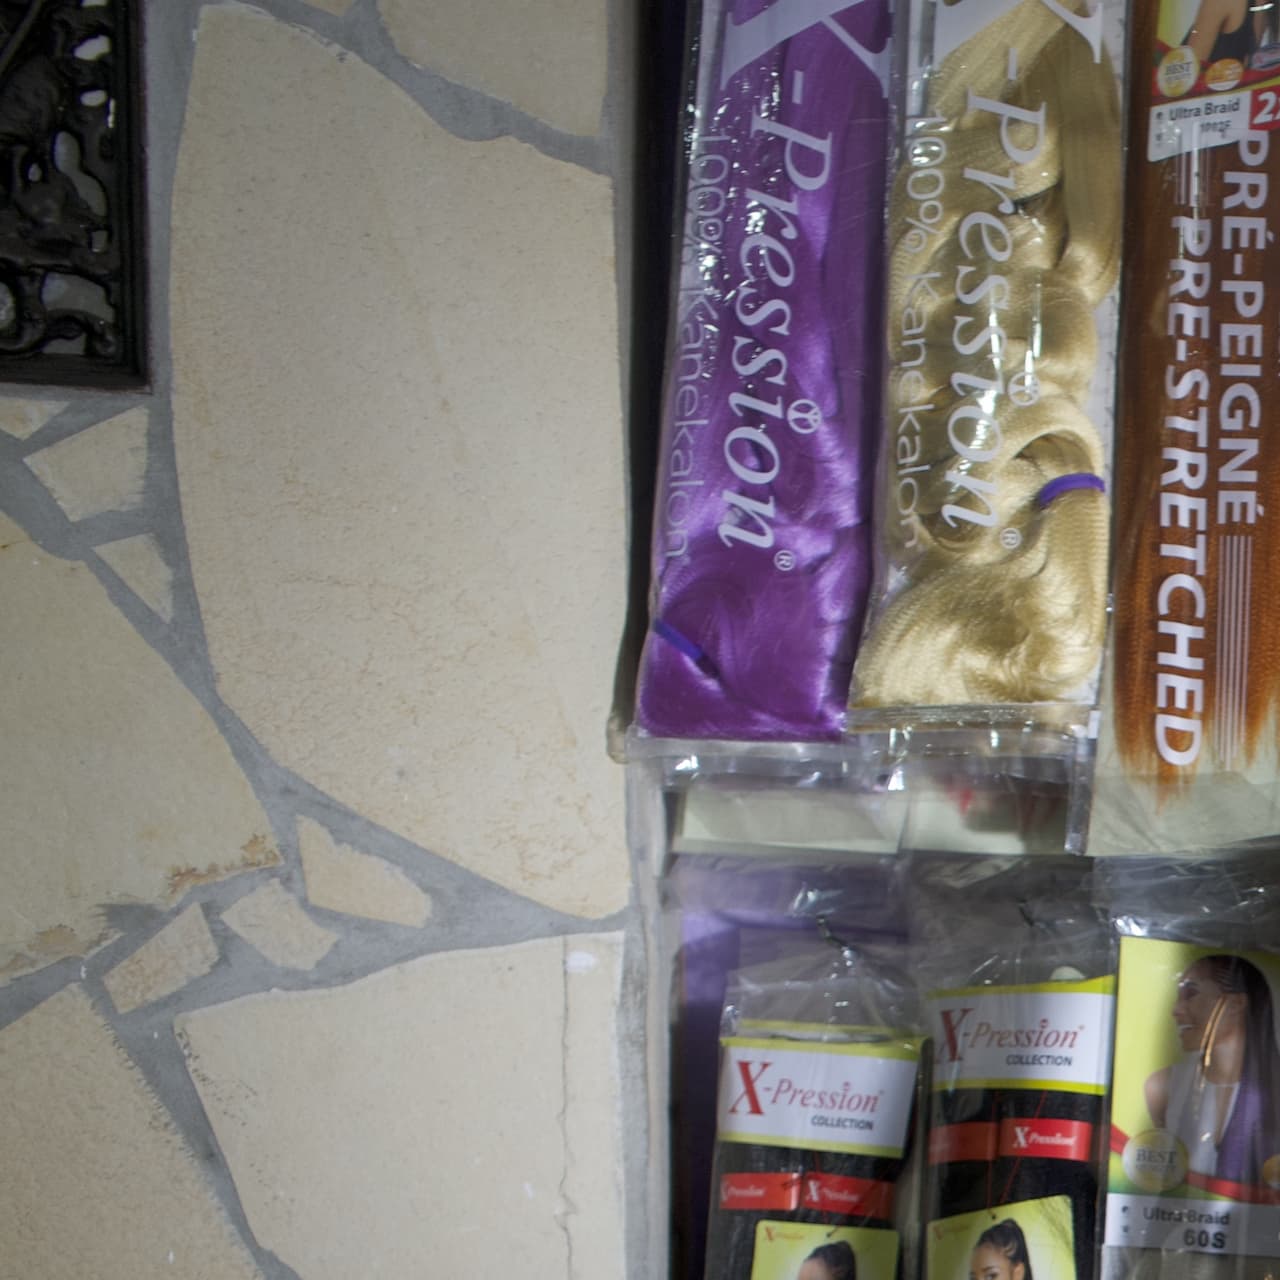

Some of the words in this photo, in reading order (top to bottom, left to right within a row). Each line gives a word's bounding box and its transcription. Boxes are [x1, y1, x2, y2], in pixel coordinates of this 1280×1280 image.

[1169, 105, 1201, 121] Ultra
[1204, 98, 1240, 115] Braid
[682, 129, 731, 265] 100%
[903, 114, 948, 254] 100%
[1215, 128, 1276, 526] PRÉ-PEIGNÉ
[665, 286, 719, 557] Kanekalon
[897, 271, 942, 548] Kanekalon
[1153, 215, 1212, 766] PRE-STRETCHED
[936, 1008, 1078, 1064] X-Pression
[1006, 1055, 1072, 1066] COLLECTION
[728, 1060, 879, 1116] X-Pression
[811, 1114, 873, 1130] COLLECTION
[1136, 1150, 1176, 1163] BEST
[1143, 1207, 1183, 1223] Ultra
[1187, 1209, 1230, 1225] Braid
[1183, 1229, 1226, 1249] 60S
